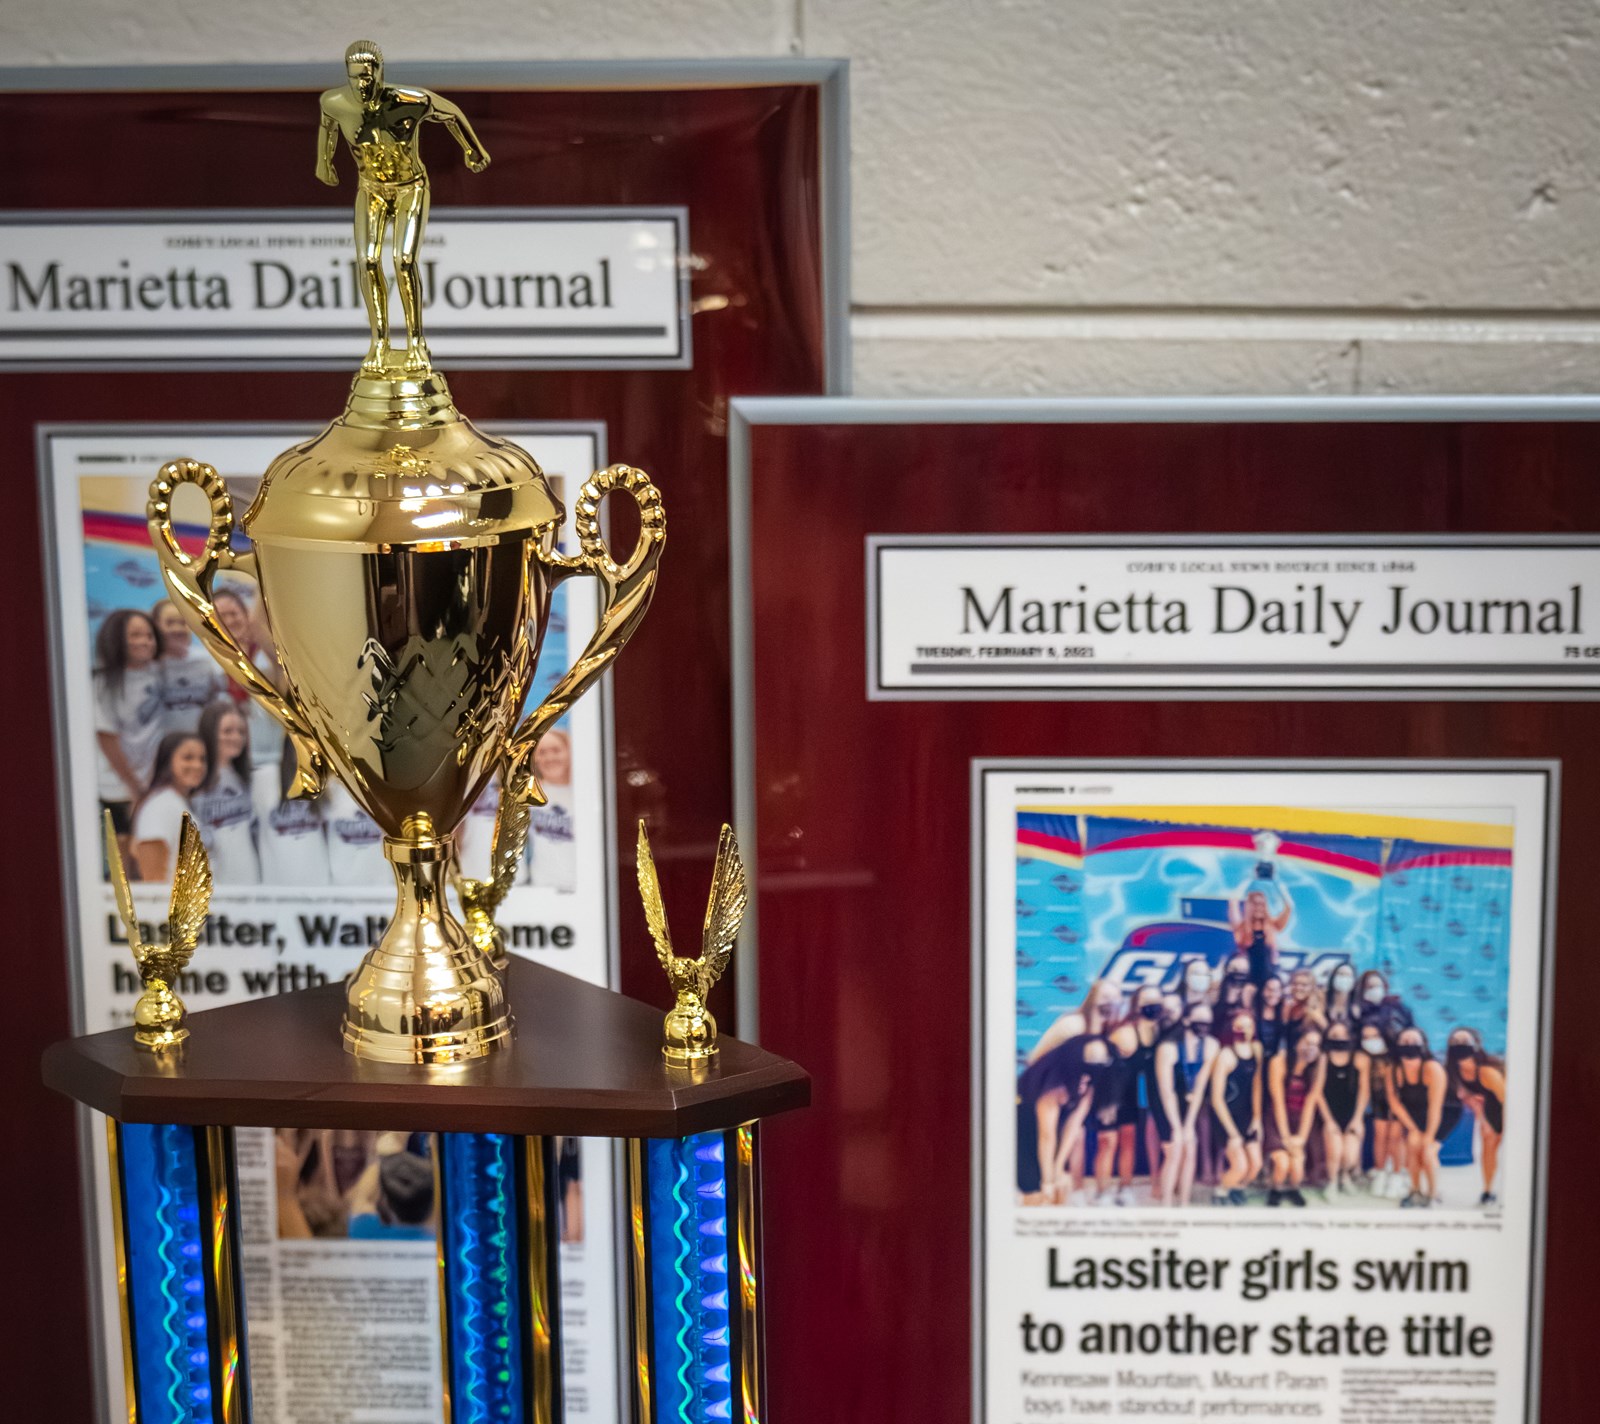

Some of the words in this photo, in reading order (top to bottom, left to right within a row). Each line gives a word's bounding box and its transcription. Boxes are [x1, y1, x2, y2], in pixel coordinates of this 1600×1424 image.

[6, 259, 231, 312] Marietta
[250, 258, 396, 312] Dail
[420, 258, 613, 313] Journal
[959, 583, 1192, 635] Marietta
[1211, 583, 1363, 649] Daily
[1380, 583, 1584, 635] Journal
[1047, 1248, 1230, 1291] Lassiter
[1241, 1250, 1339, 1301] girls
[1353, 1251, 1469, 1293] swim
[1020, 1313, 1064, 1354] to
[1079, 1313, 1259, 1355] another
[1271, 1315, 1388, 1357] state
[1402, 1316, 1493, 1358] title
[1020, 1370, 1111, 1390] Kennesaw
[1117, 1370, 1204, 1393] Mountain,
[1212, 1371, 1269, 1391] Mount
[1276, 1372, 1328, 1391] Paran
[1025, 1395, 1064, 1417] boys
[1070, 1396, 1111, 1415] have
[1117, 1396, 1195, 1416] standout
[1201, 1397, 1322, 1420] performances
